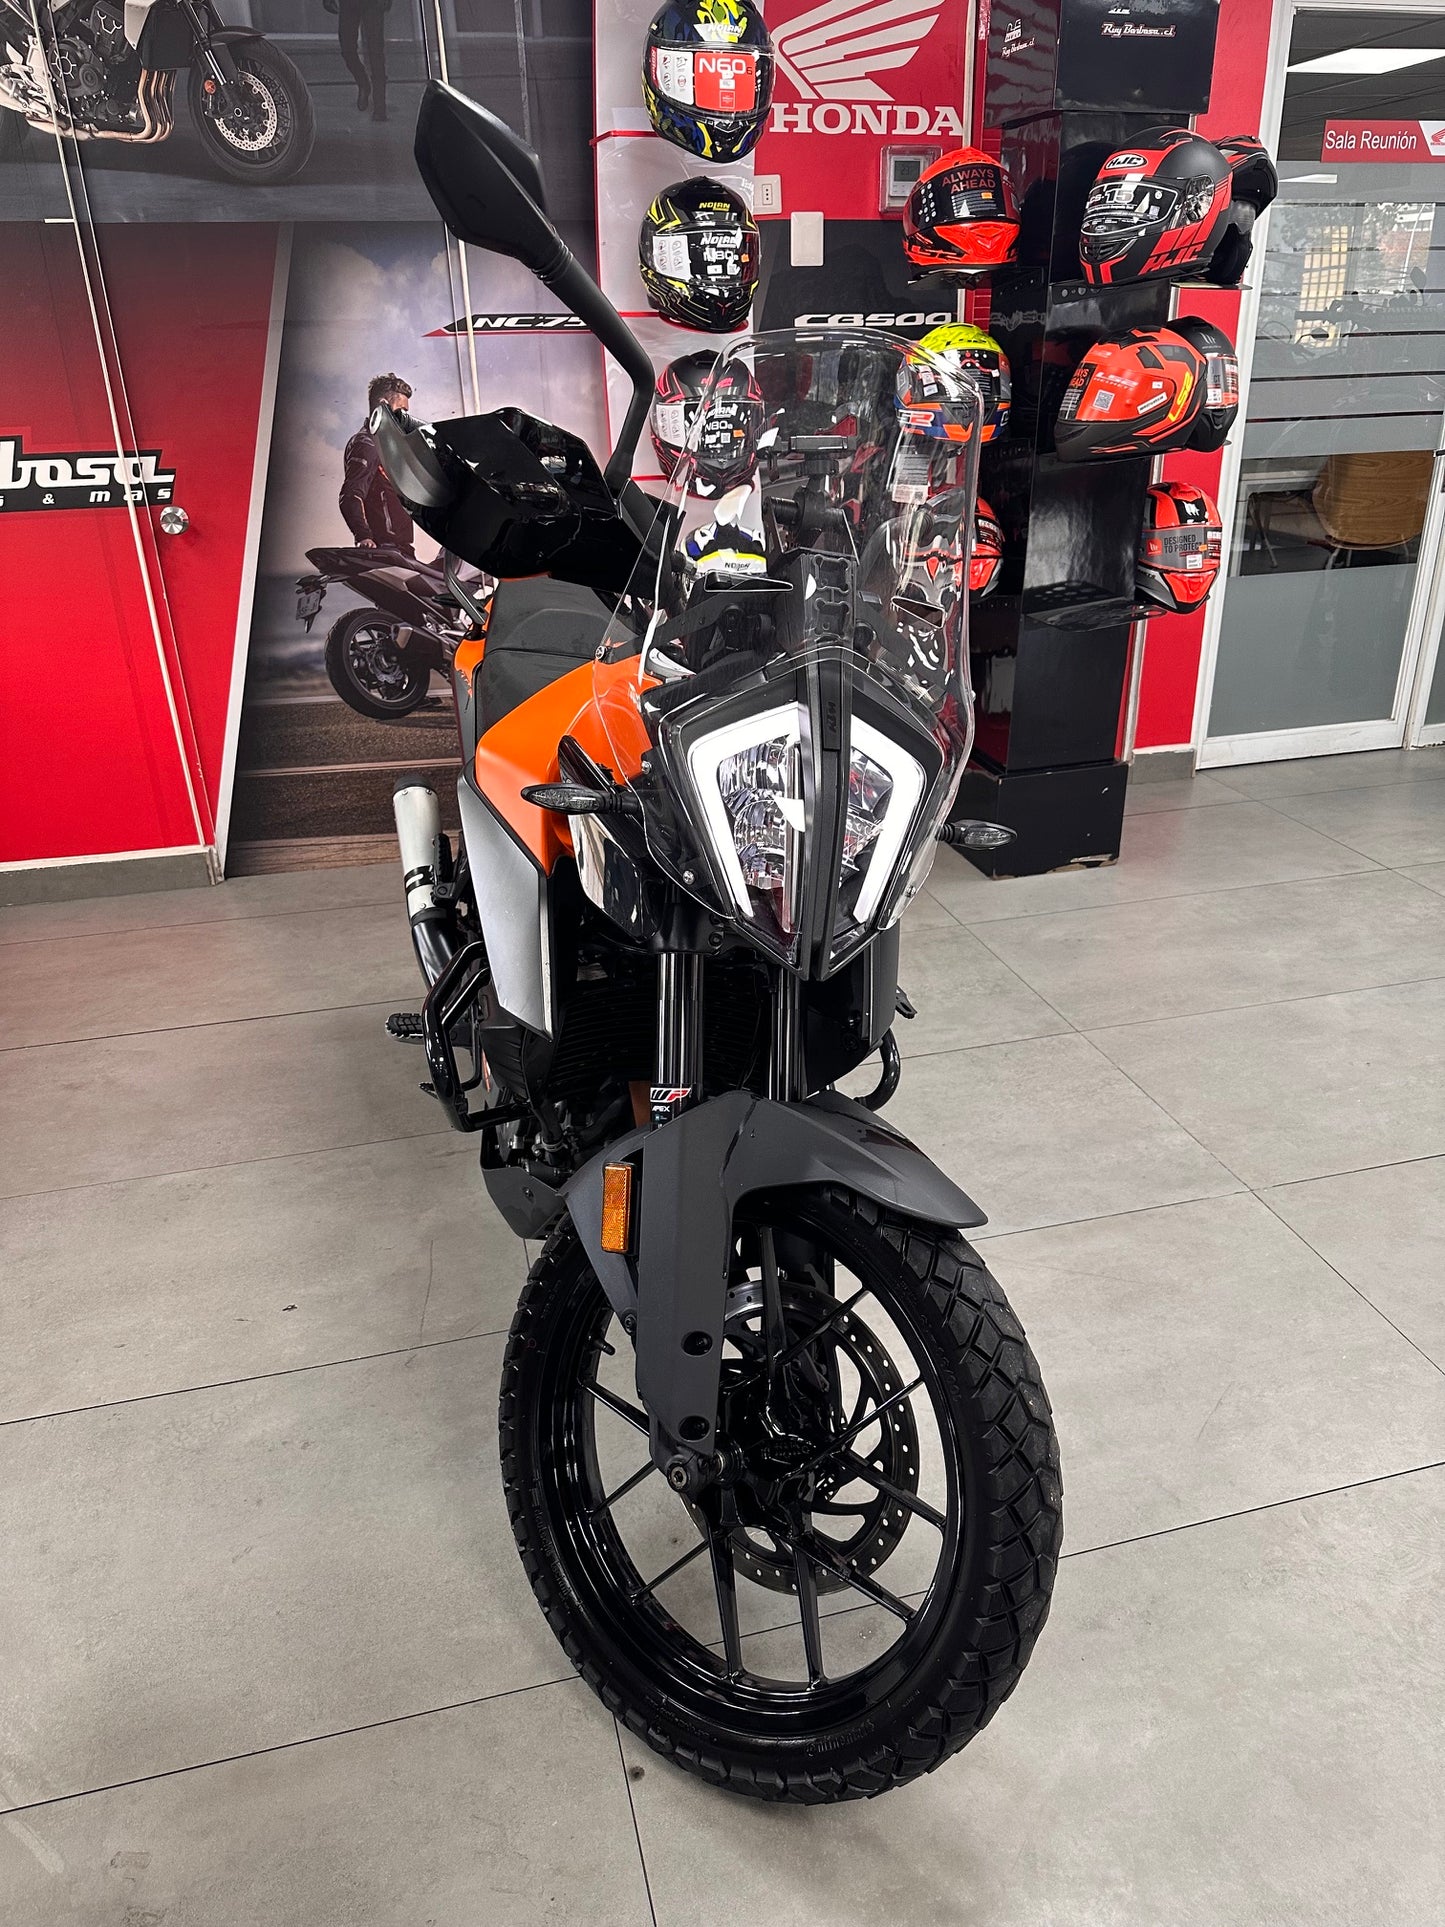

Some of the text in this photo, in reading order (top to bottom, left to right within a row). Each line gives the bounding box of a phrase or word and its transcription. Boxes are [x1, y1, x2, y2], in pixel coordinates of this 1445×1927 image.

[1103, 23, 1122, 37] Ruy
[769, 102, 963, 136] HONDA
[1325, 130, 1417, 150] Sala Reunión
[1106, 156, 1141, 168] HJC
[942, 168, 995, 187] ALWAYS
[951, 179, 996, 194] AHEAD
[699, 202, 730, 211] NOLAN
[1138, 243, 1205, 276] HJC
[794, 312, 953, 328] CB500
[1168, 371, 1194, 423] LS2
[42, 493, 55, 505] &
[1164, 534, 1197, 546] DESIGNED
[1165, 545, 1175, 554] TO
